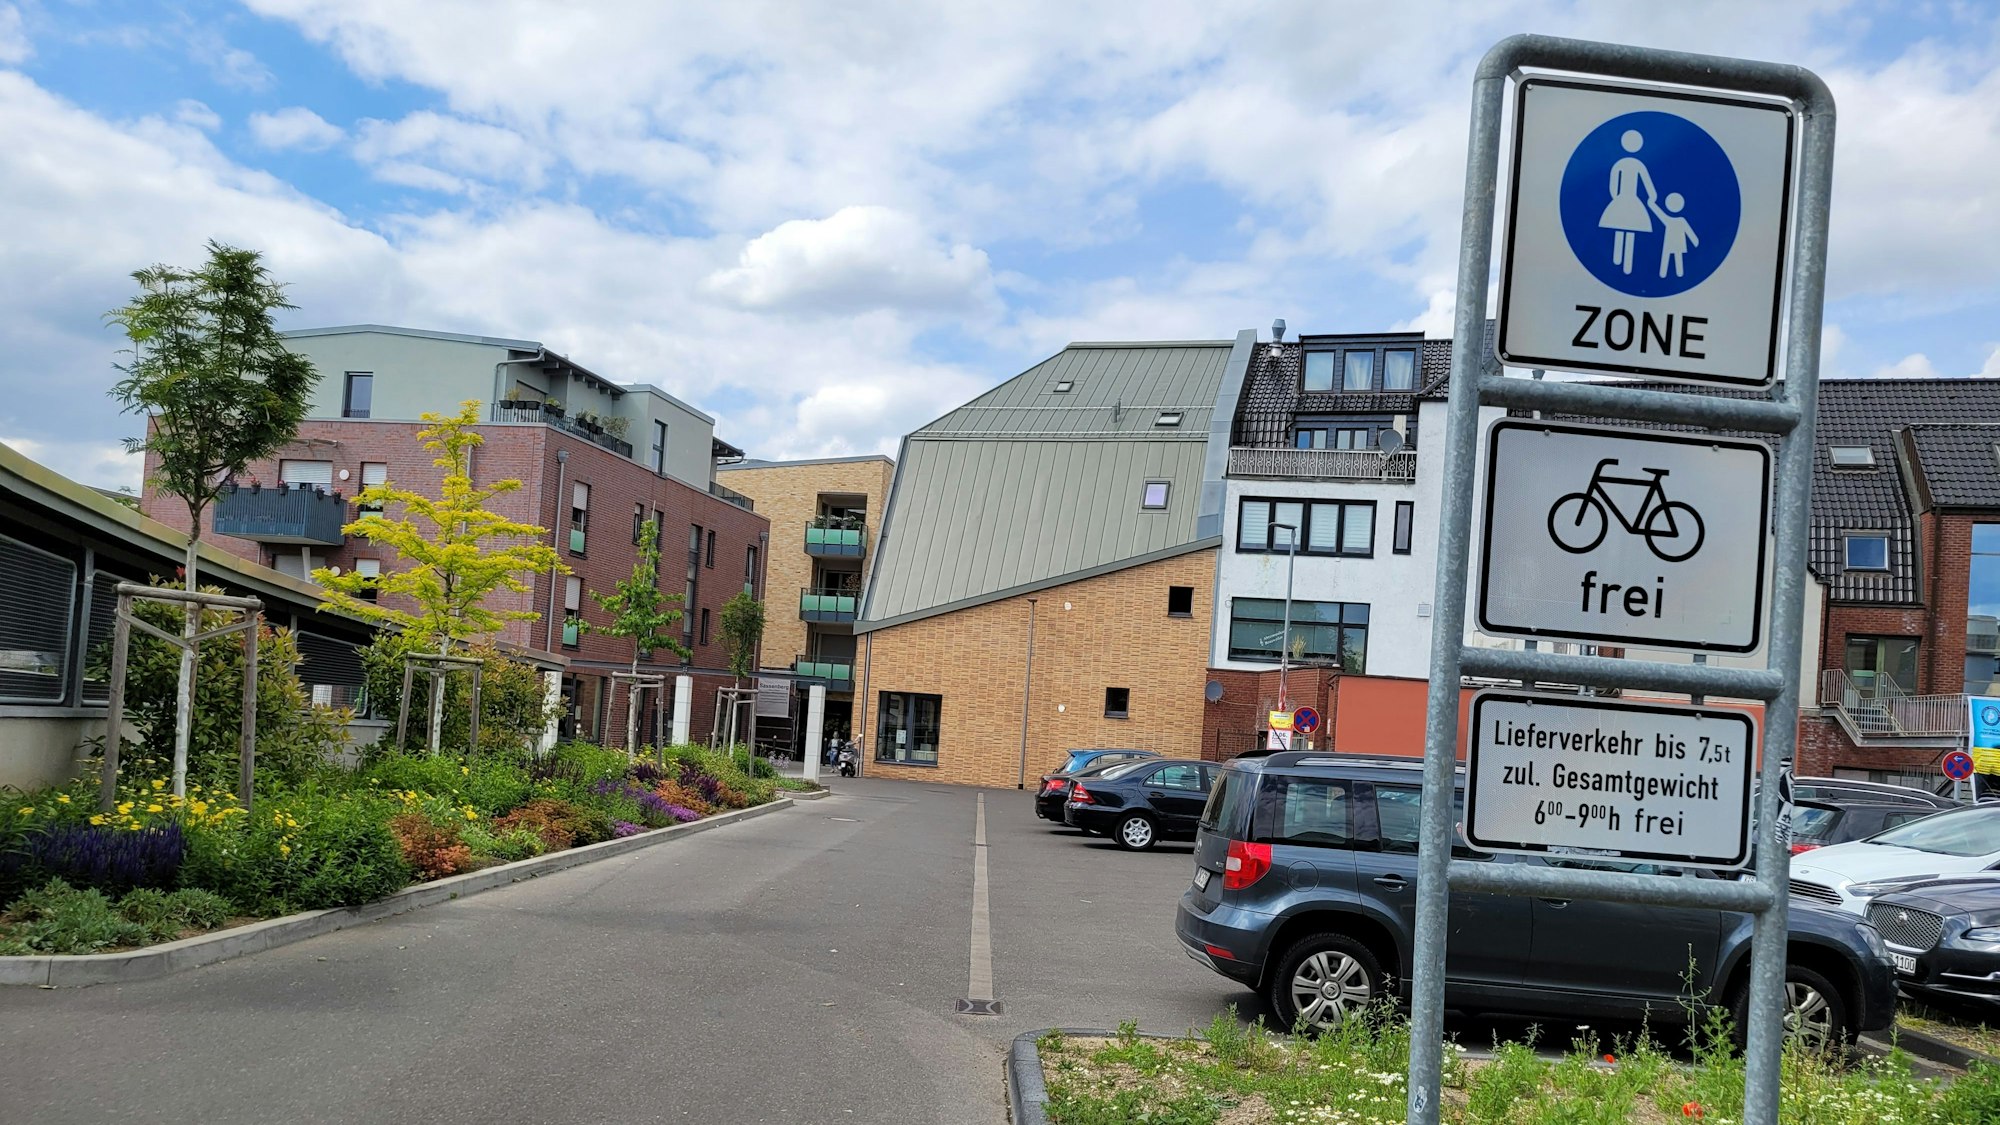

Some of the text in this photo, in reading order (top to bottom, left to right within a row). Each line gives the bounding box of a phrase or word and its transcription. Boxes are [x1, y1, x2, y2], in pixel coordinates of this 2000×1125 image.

[1571, 304, 1709, 359] ZONE
[1580, 570, 1664, 619] frei
[1494, 719, 1644, 756] Lieferverkehr
[1655, 732, 1686, 760] bis
[1502, 760, 1719, 802] zul. Gesamtgewicht
[1634, 807, 1684, 836] frei
